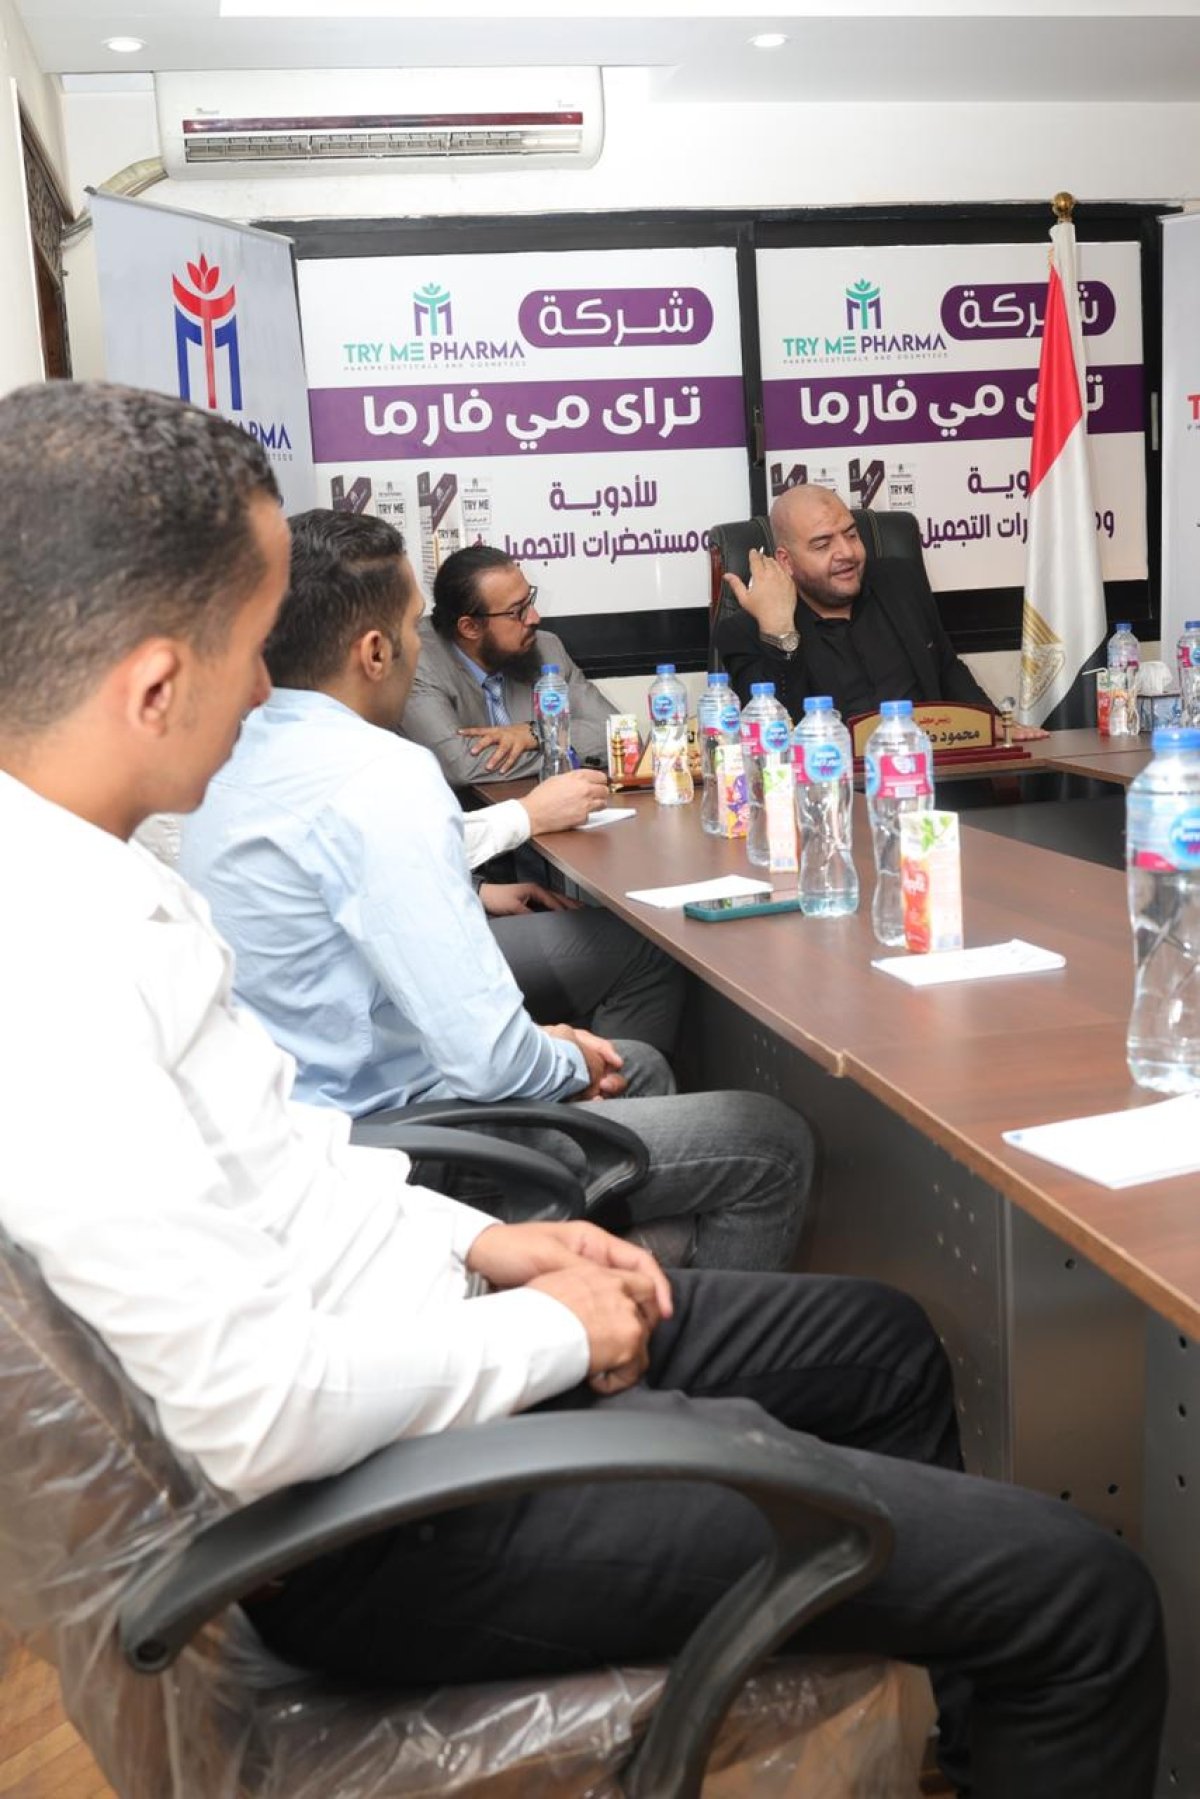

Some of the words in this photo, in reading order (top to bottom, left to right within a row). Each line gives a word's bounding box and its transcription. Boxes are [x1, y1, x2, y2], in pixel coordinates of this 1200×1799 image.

[538, 291, 694, 346] شركة
[343, 343, 383, 363] TRY
[391, 342, 424, 361] ME
[430, 340, 525, 361] PHARMA
[783, 337, 819, 357] TRY
[825, 336, 856, 354] ME
[861, 333, 947, 353] PHARMA
[363, 389, 493, 447] فارما
[506, 395, 590, 450] مي
[800, 379, 917, 434] فارما
[928, 381, 1004, 437] مي
[378, 503, 392, 514] TRY
[550, 475, 658, 516] للأدوية
[921, 513, 991, 549] التجميل
[940, 729, 980, 745] محمود
